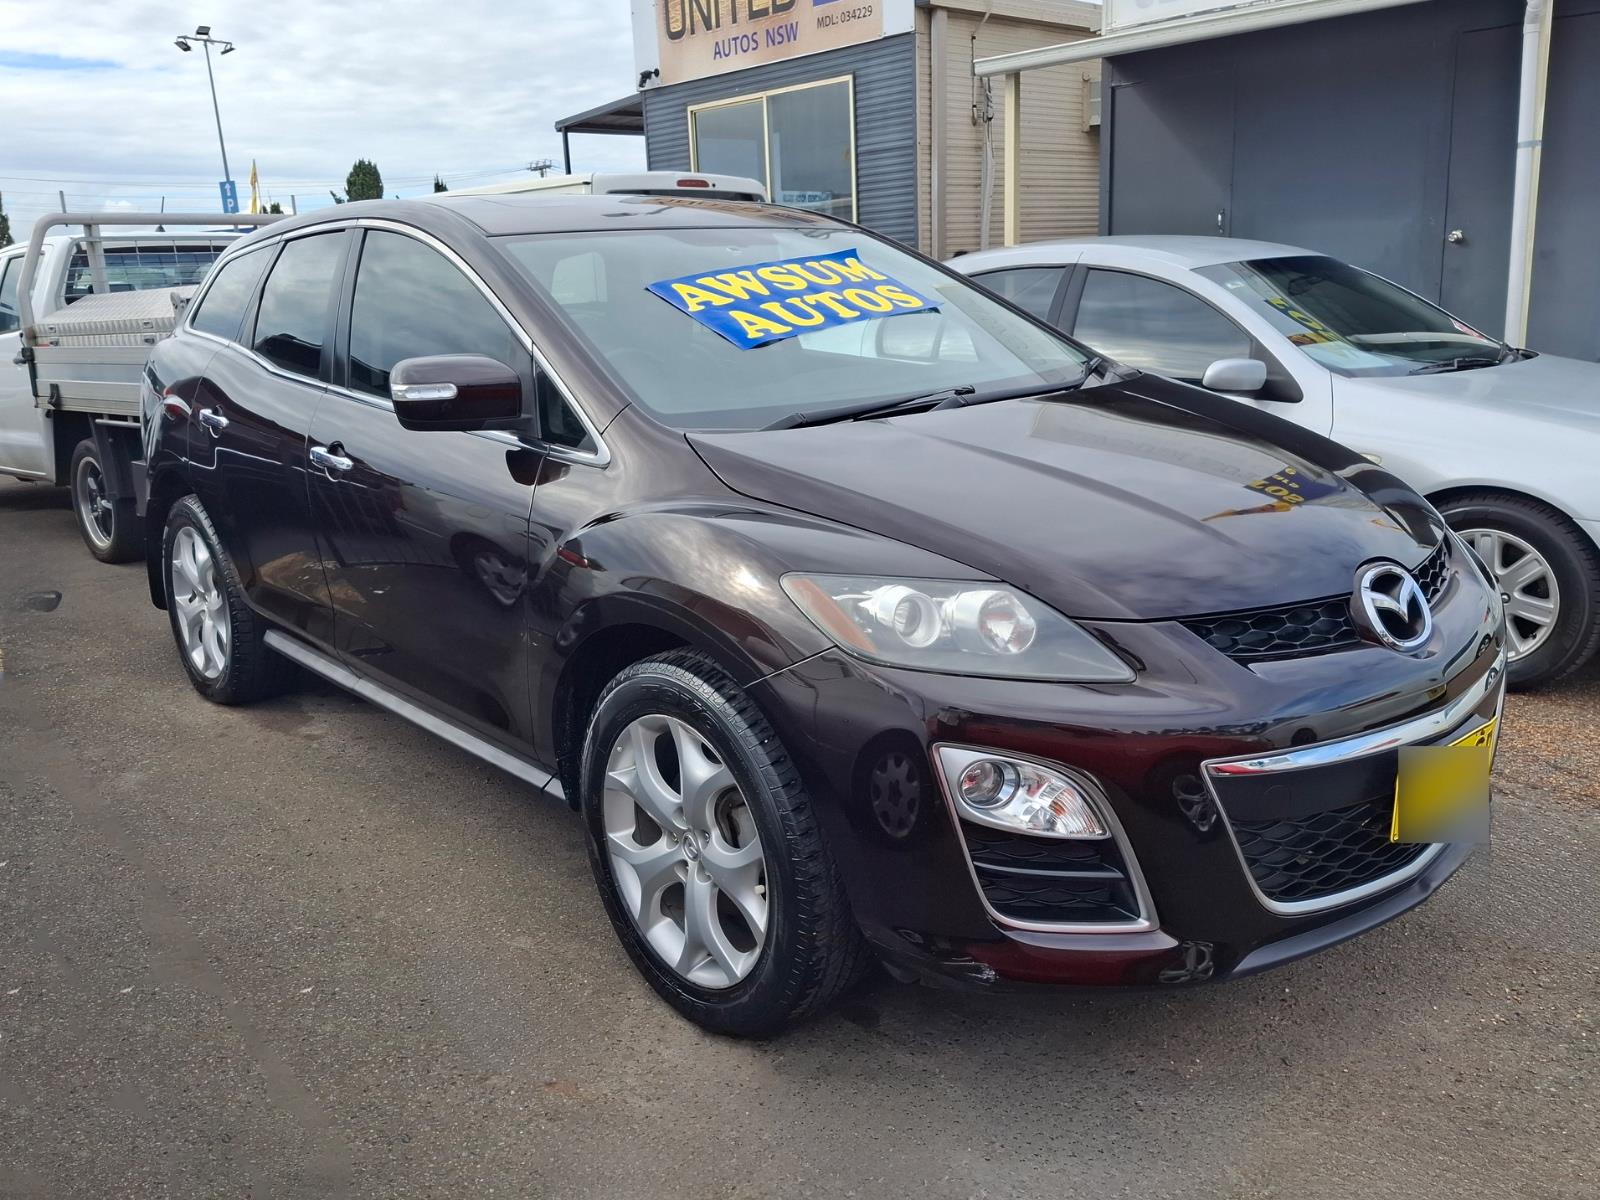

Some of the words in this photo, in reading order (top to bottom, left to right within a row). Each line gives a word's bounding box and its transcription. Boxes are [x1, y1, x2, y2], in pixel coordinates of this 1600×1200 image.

[664, 0, 796, 40] UNI
[817, 14, 839, 29] MDL:
[840, 5, 873, 23] 034229
[713, 32, 759, 60] AUTOS
[765, 21, 799, 48] NSW
[671, 257, 888, 312] AWSUM
[729, 285, 924, 339] AUTOS
